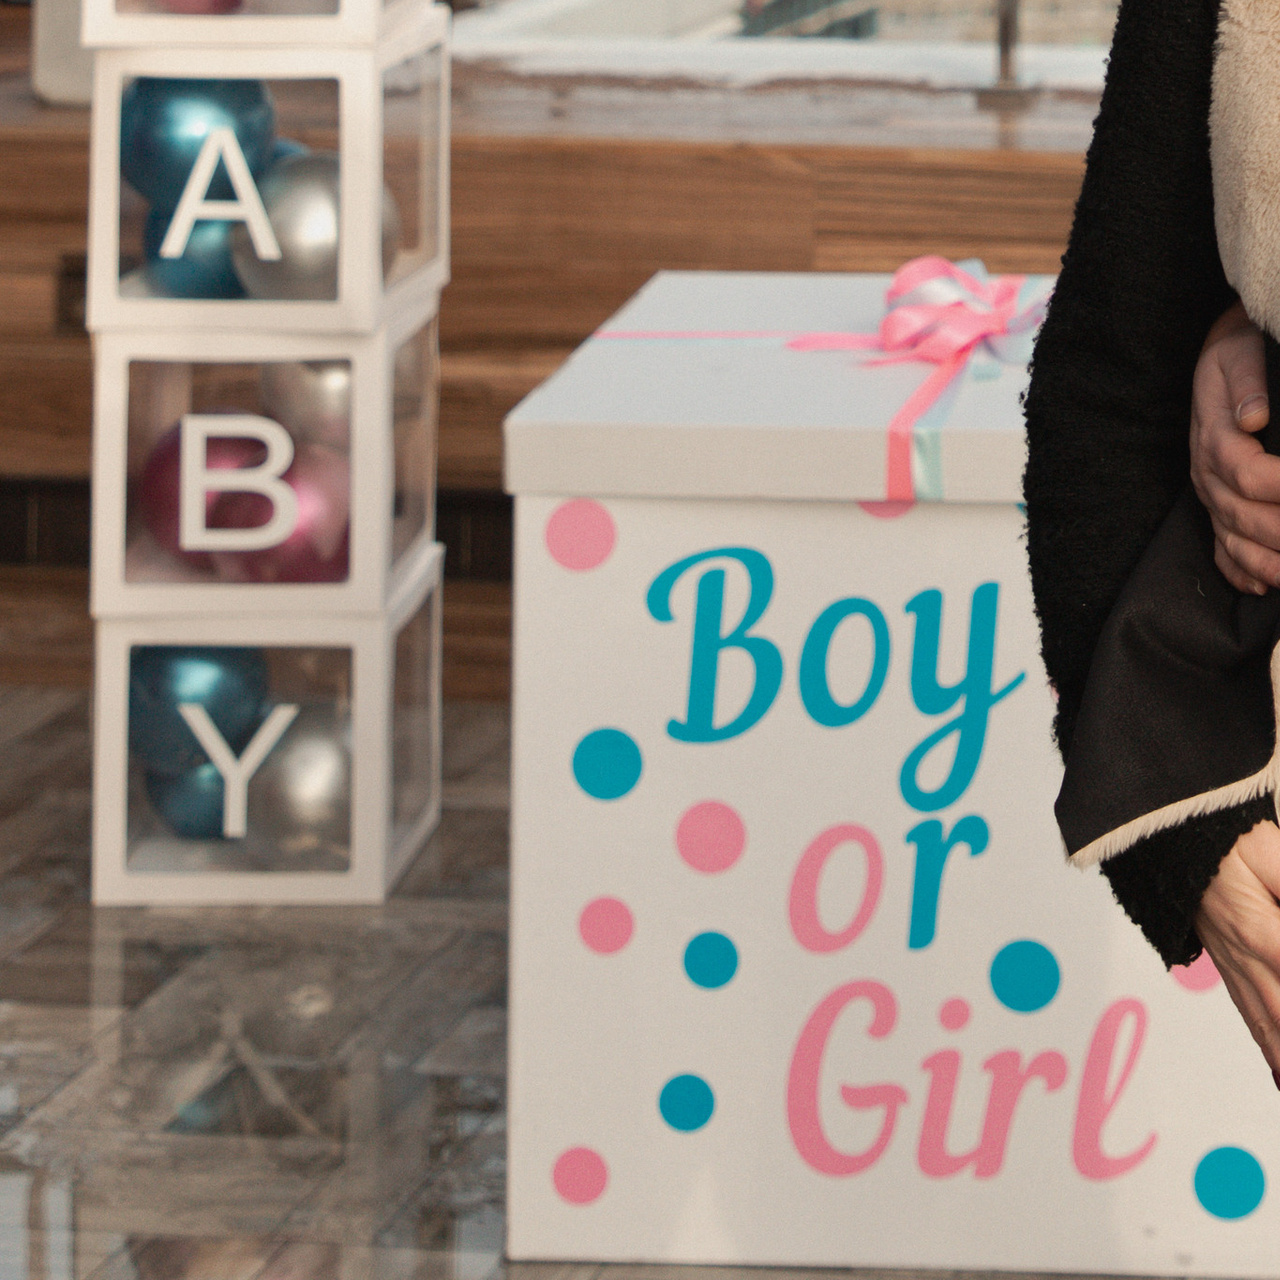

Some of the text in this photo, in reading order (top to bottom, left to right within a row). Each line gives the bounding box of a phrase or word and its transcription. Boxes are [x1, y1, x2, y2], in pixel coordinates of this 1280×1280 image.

[646, 546, 1026, 813] Boy
[787, 813, 990, 955] or
[786, 978, 1159, 1181] Girl
